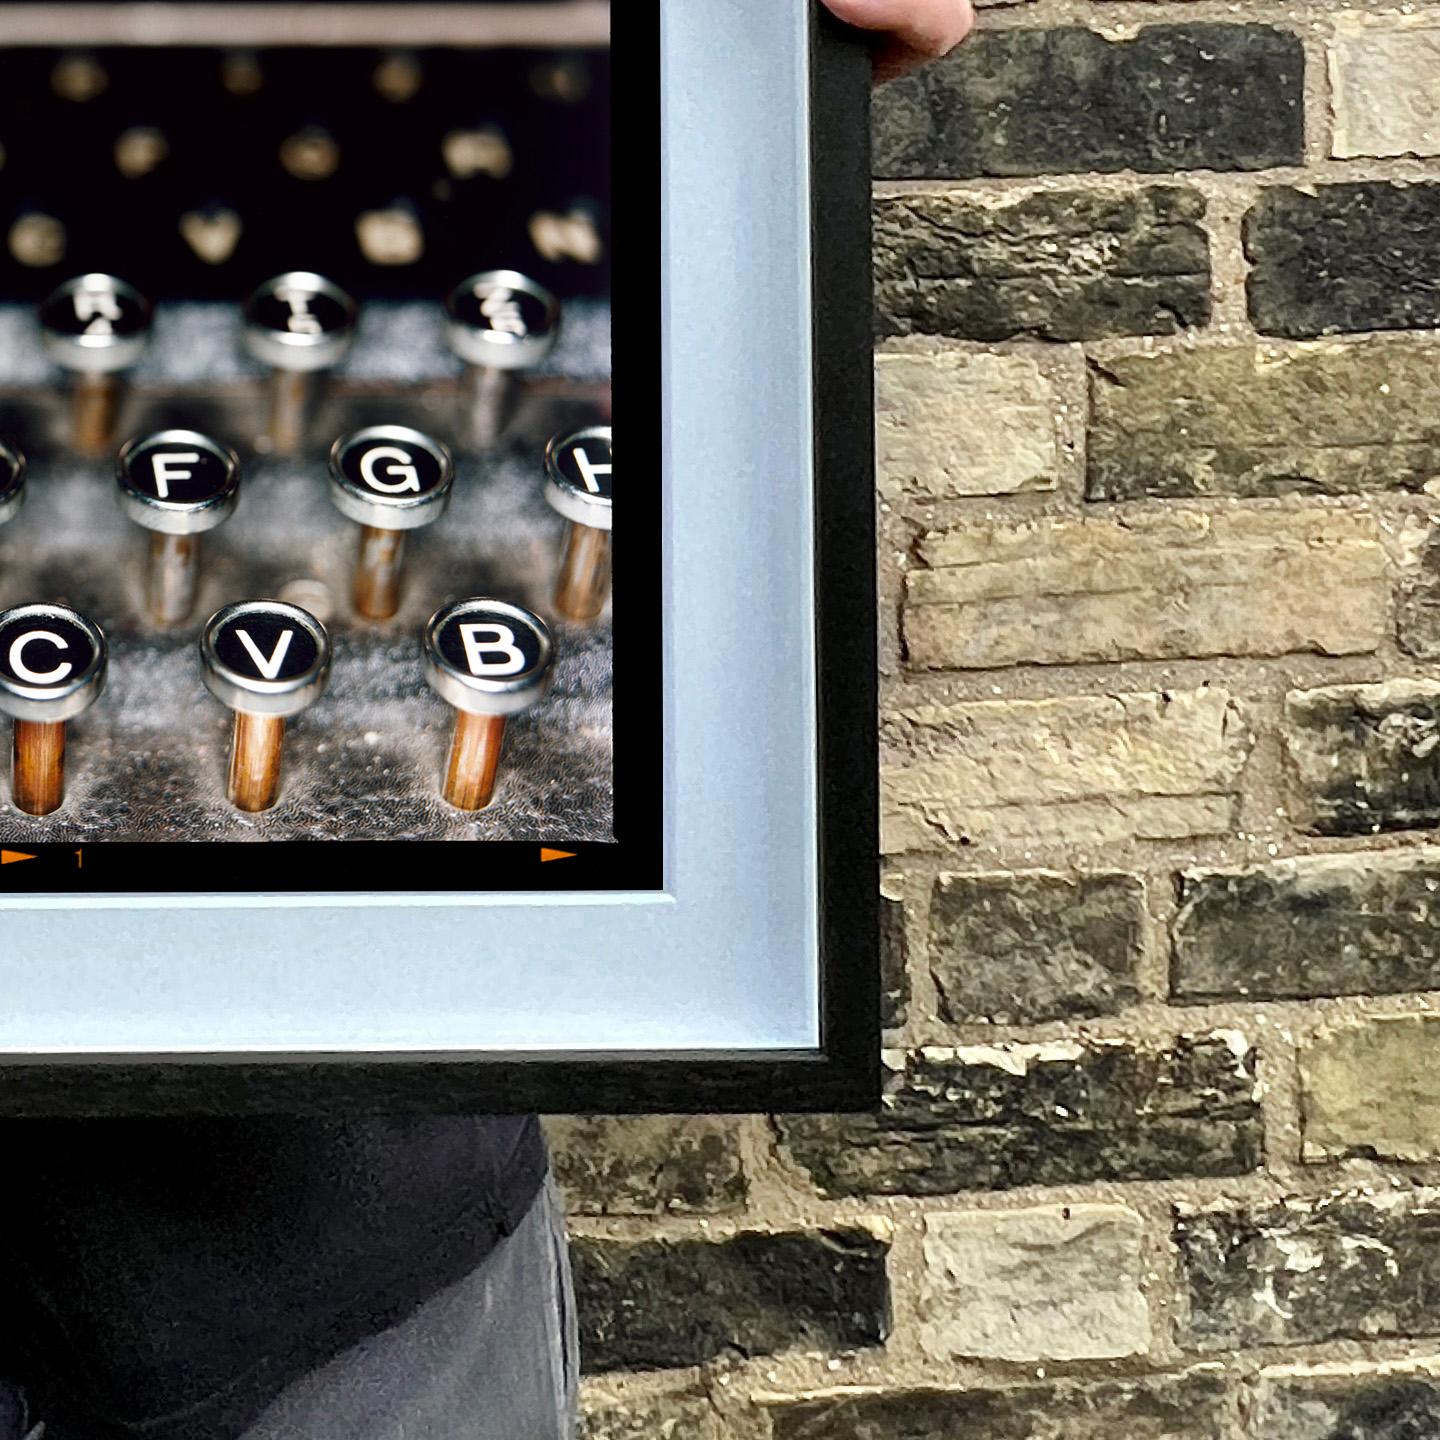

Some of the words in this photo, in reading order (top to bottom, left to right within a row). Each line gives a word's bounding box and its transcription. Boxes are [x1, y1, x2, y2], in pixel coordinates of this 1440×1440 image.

[152, 452, 200, 498] F
[360, 446, 420, 493] G
[9, 630, 73, 685] C
[235, 629, 294, 680] V
[459, 623, 526, 677] B
[74, 848, 83, 869] 1
